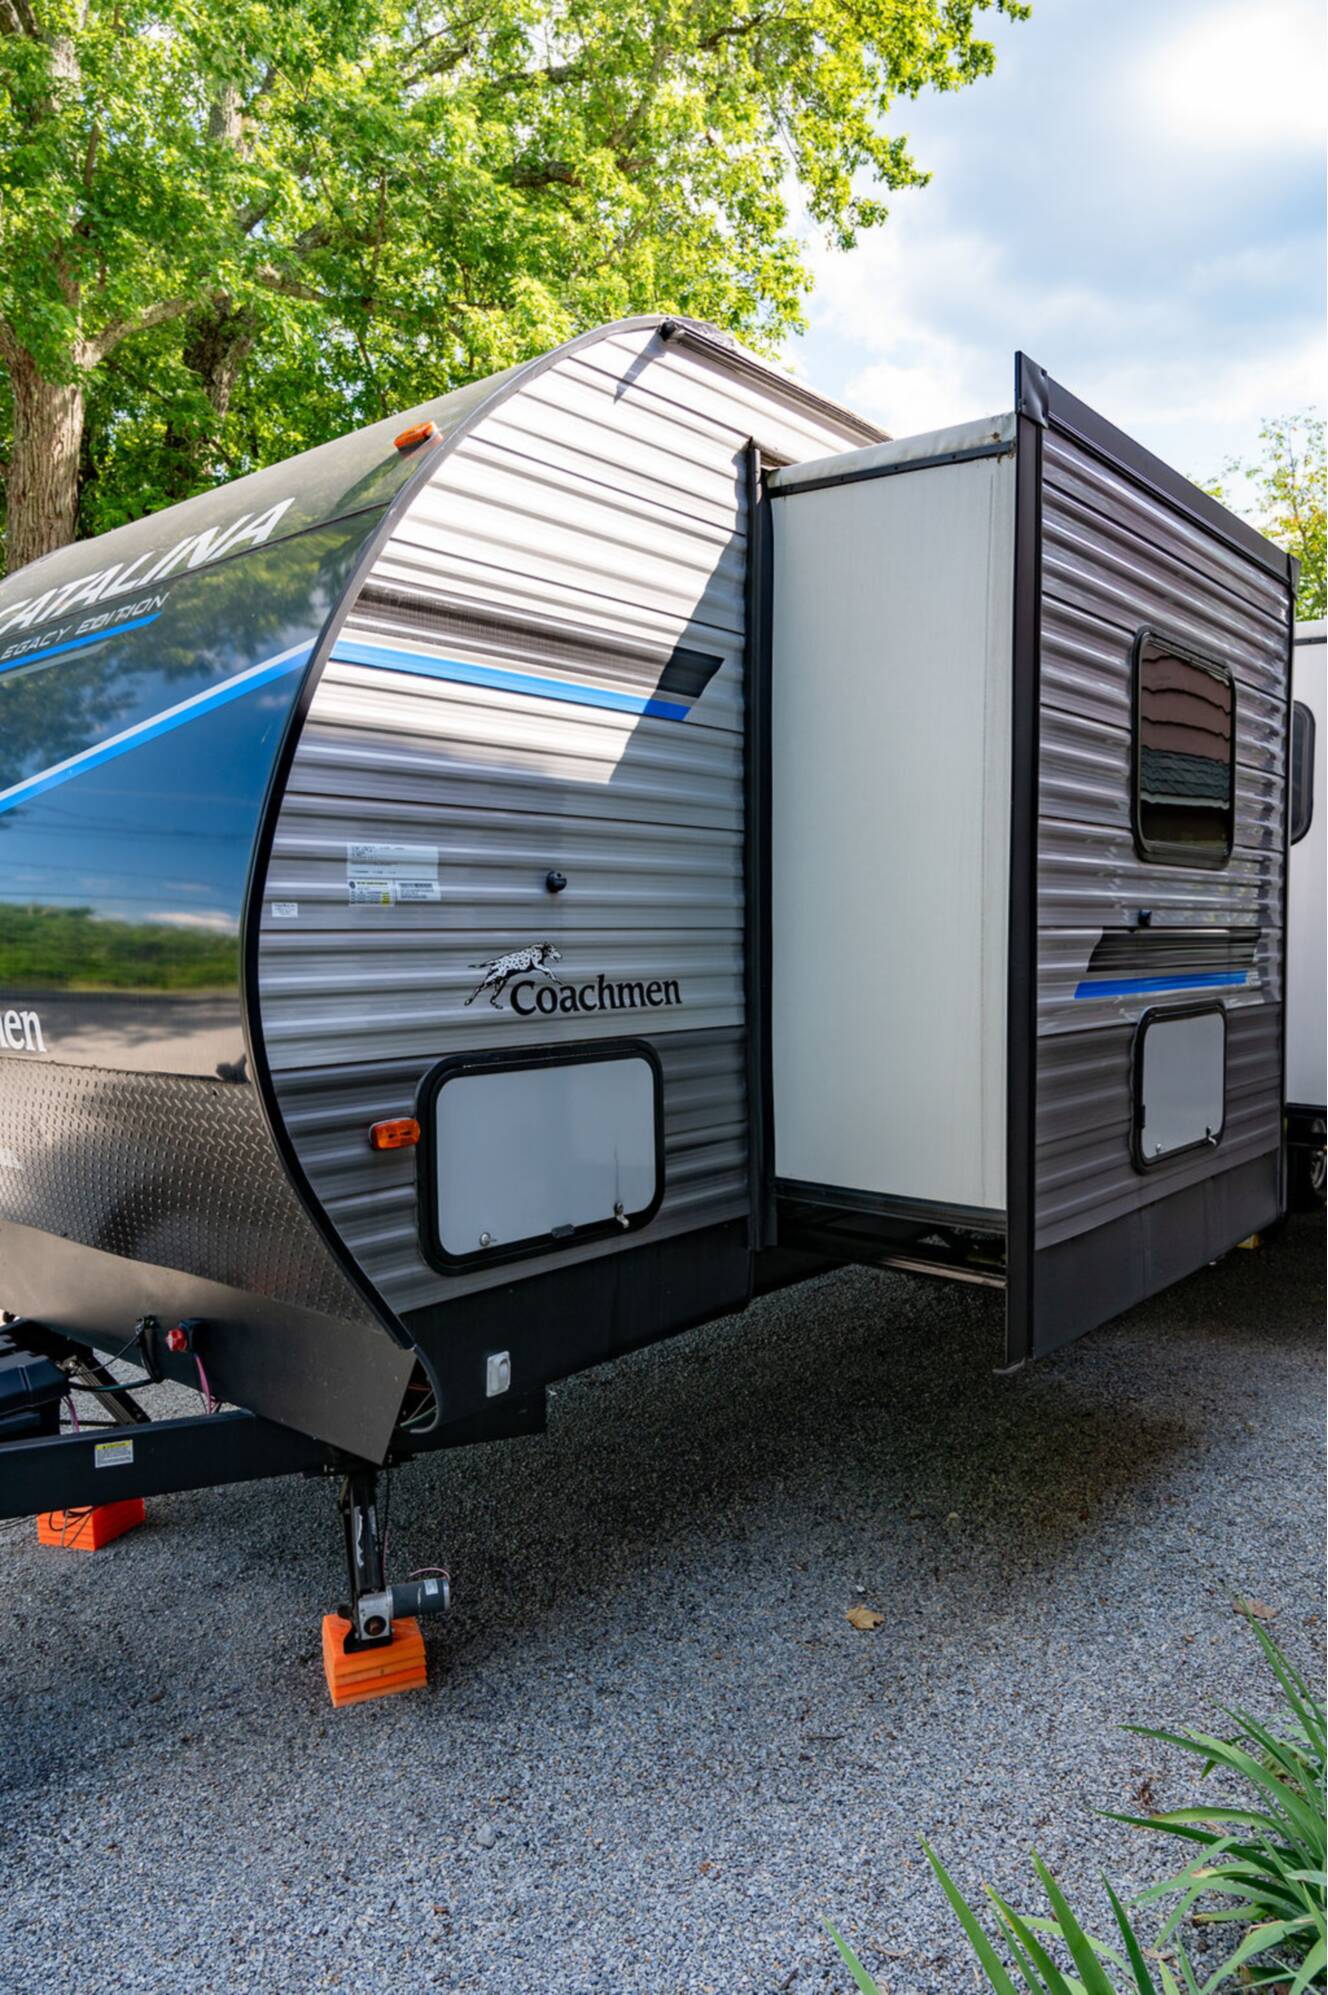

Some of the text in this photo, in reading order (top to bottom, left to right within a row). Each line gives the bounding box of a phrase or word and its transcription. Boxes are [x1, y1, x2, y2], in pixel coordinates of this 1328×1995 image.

[0, 592, 170, 660] EGACY EDITION
[509, 974, 683, 1016] Coachmen
[0, 1009, 47, 1052] en
